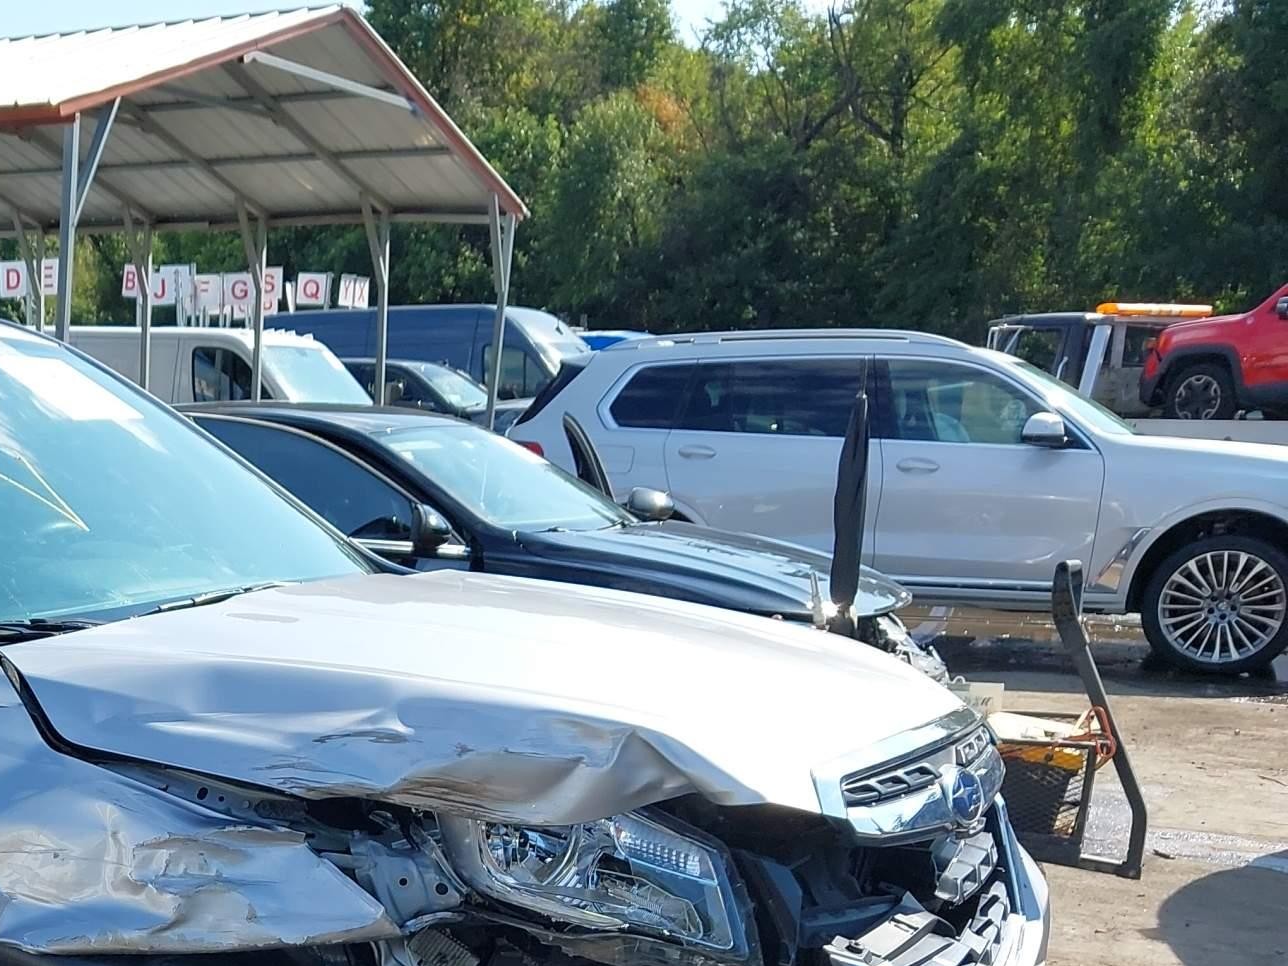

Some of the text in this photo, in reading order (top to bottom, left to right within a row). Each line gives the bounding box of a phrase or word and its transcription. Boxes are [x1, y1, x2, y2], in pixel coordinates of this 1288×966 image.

[6, 268, 21, 290] D
[125, 271, 136, 290] B
[153, 278, 166, 299] J
[232, 279, 249, 300] G
[263, 273, 275, 293] S
[302, 279, 320, 300] Q
[344, 278, 352, 300] Y
[357, 279, 366, 303] X
